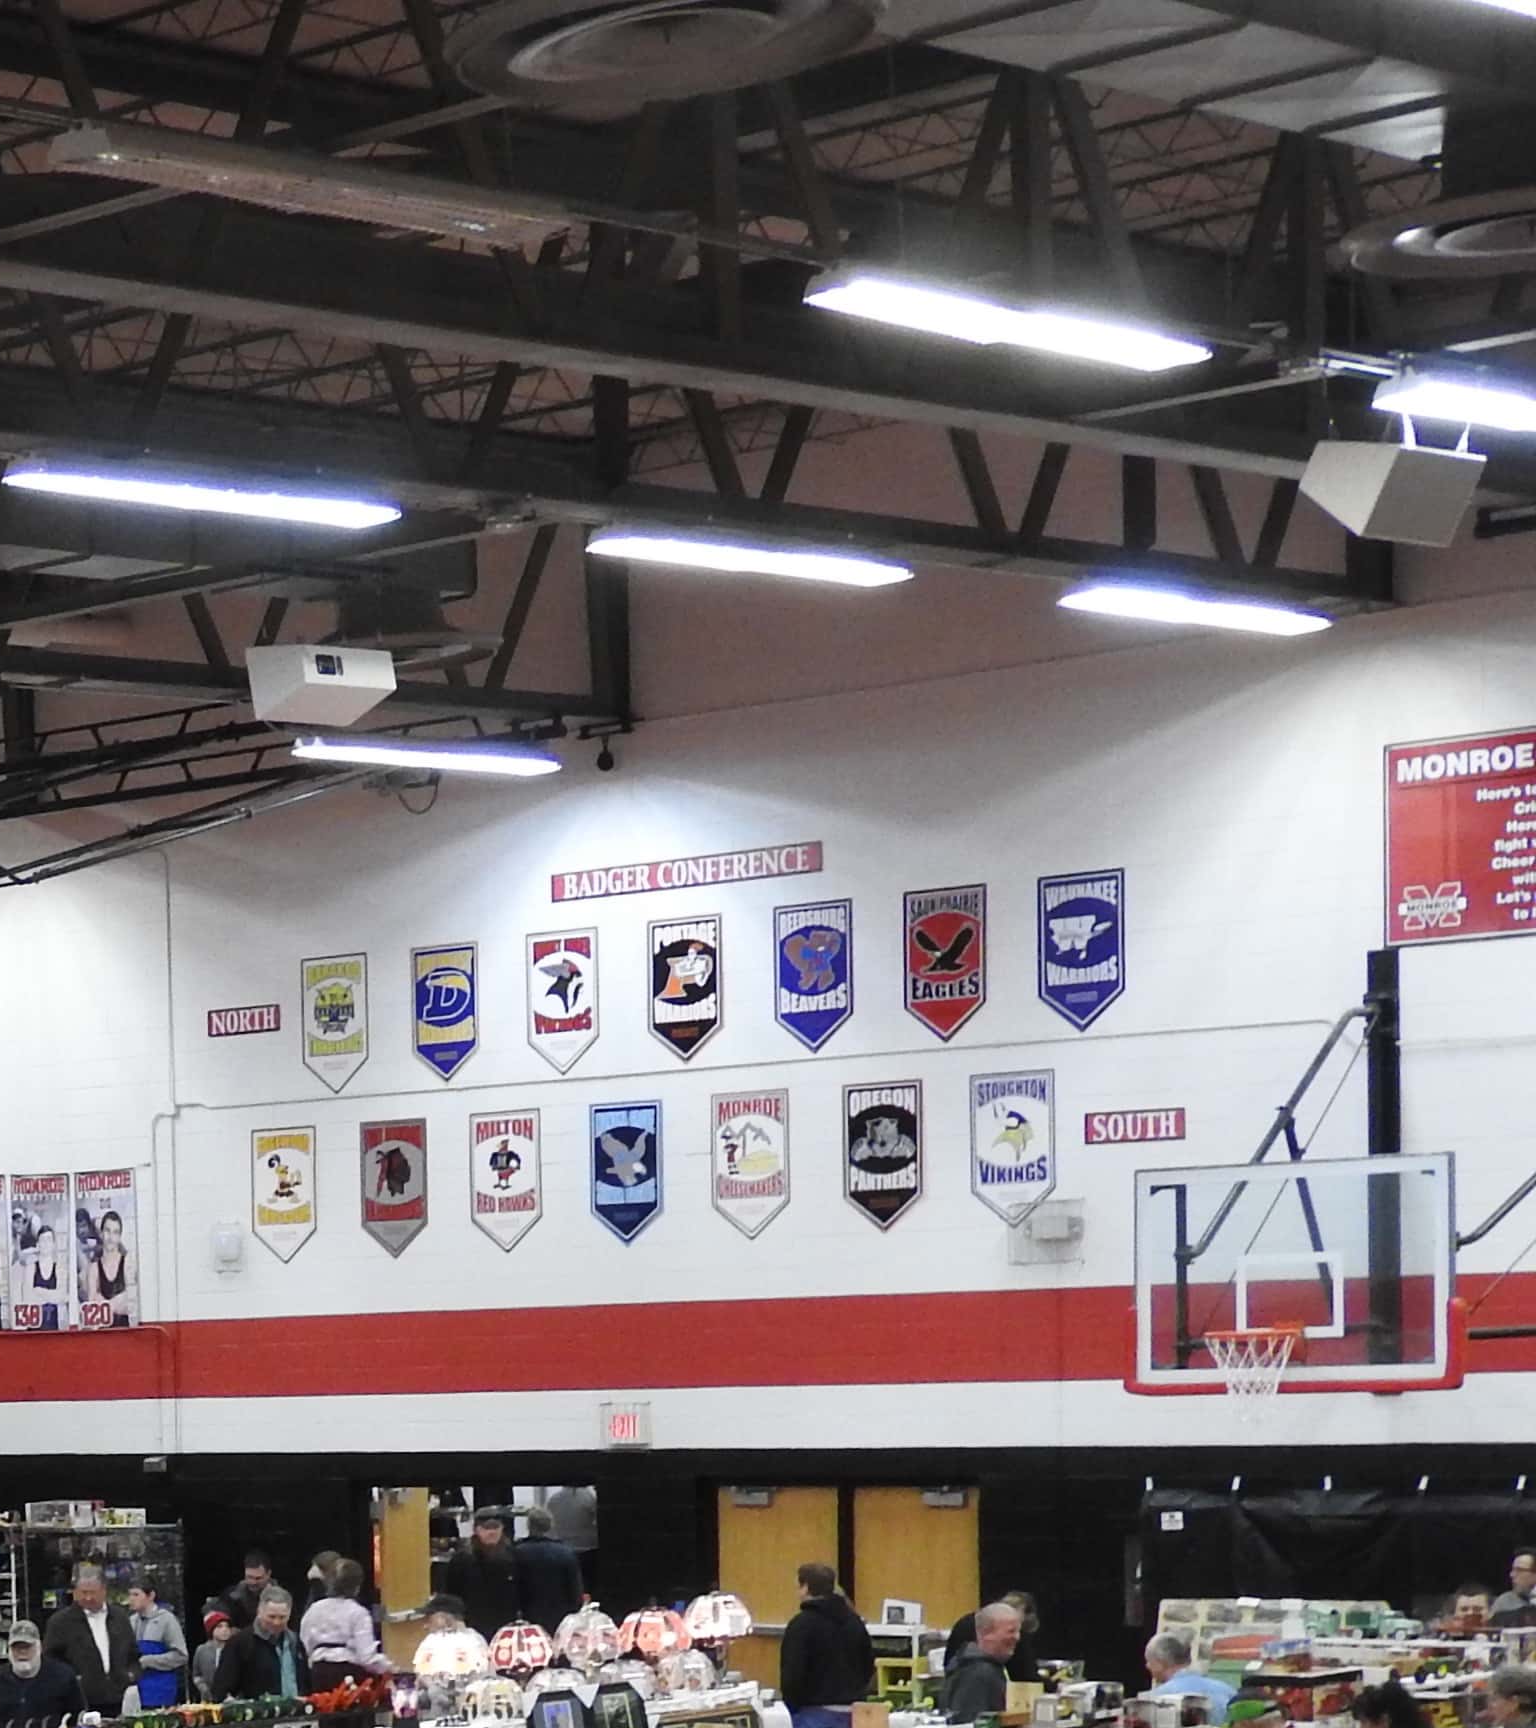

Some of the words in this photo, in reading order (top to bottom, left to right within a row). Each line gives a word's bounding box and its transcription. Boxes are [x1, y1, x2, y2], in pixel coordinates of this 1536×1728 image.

[1397, 743, 1535, 783] MONROE
[563, 865, 652, 900] BADGER
[657, 846, 809, 889] CONFERENCE
[1406, 900, 1459, 913] MONROE
[911, 971, 980, 1000] EAGLES
[210, 1006, 277, 1035] NORTH
[976, 1077, 1047, 1105] STOUGHTON
[717, 1098, 782, 1121] MONROE
[476, 1117, 534, 1144] MILTON
[1092, 1111, 1177, 1142] SOUTH
[978, 1155, 1048, 1185] VIKINGS
[81, 1303, 112, 1326] 120
